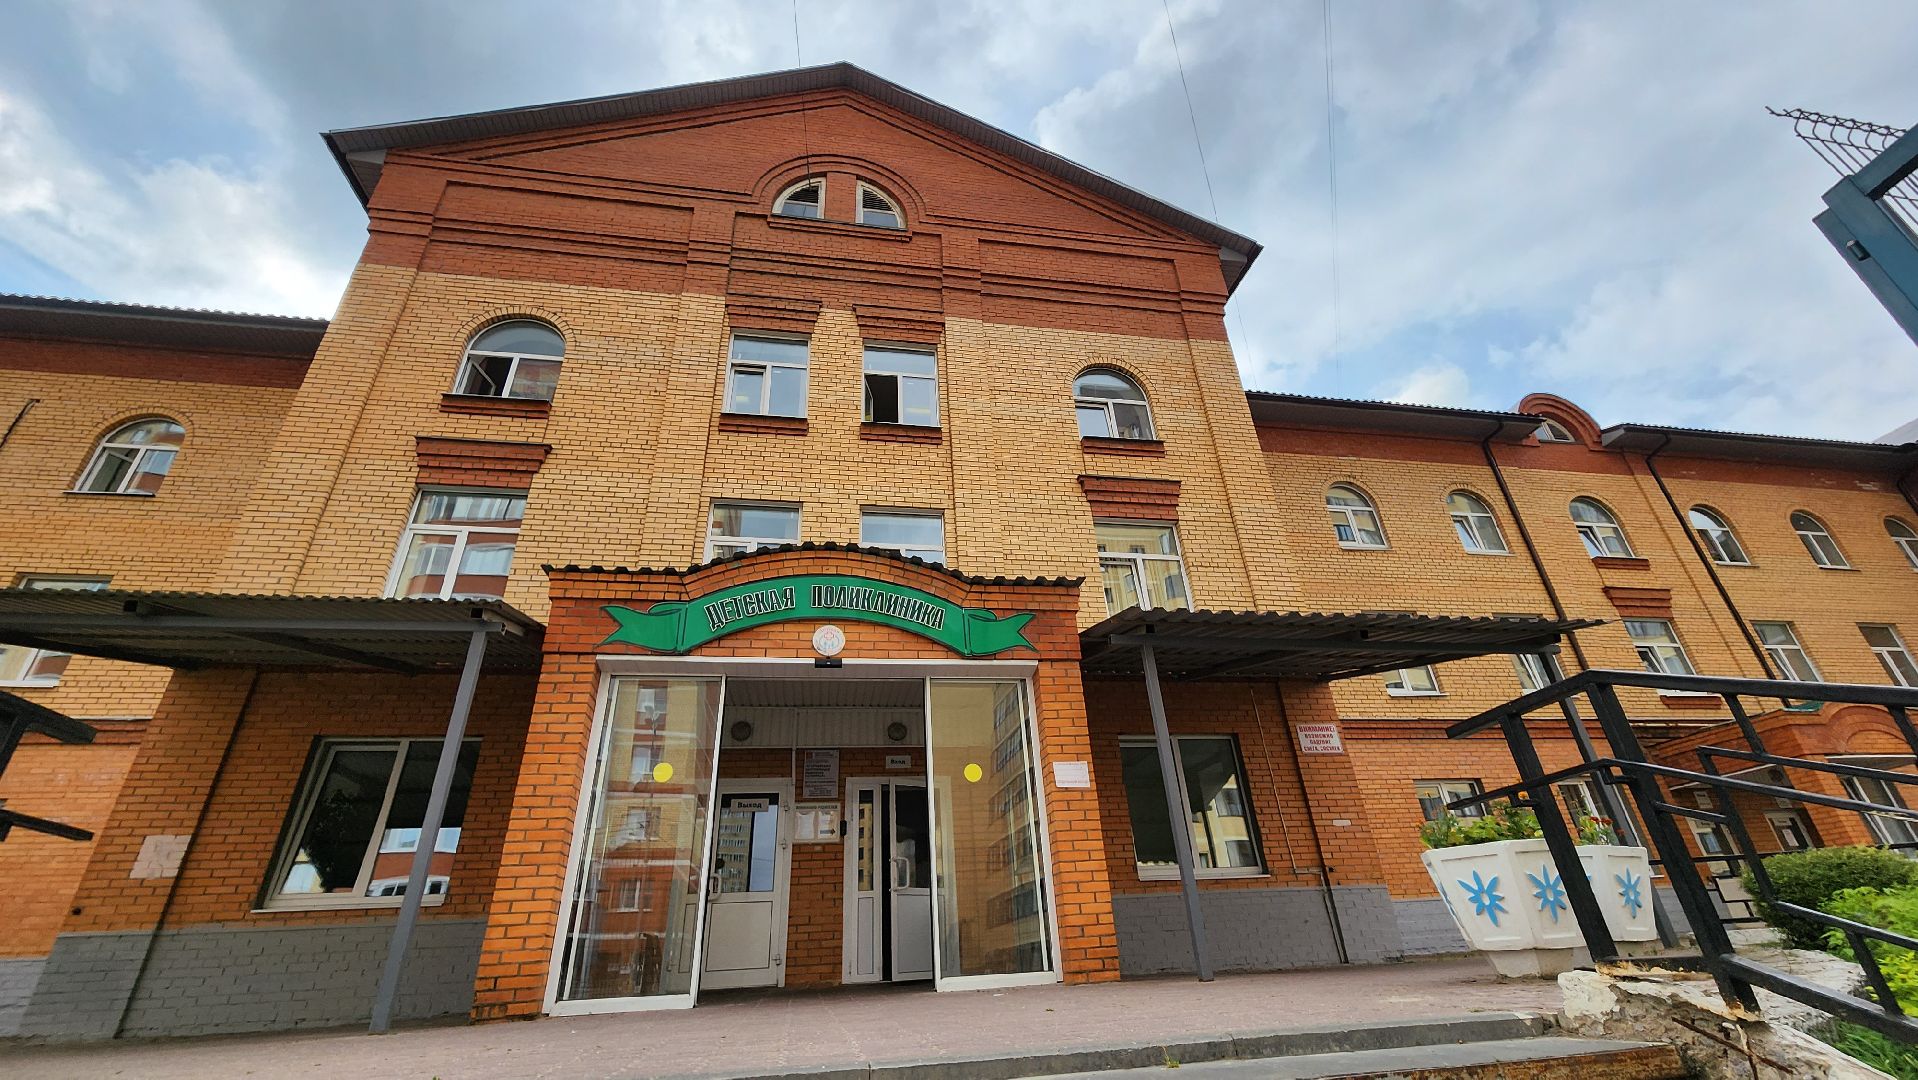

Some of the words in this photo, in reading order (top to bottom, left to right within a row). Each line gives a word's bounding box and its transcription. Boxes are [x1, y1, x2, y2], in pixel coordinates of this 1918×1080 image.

[704, 586, 795, 631] ДЕТСКАЯ
[811, 584, 945, 630] ПОЛИКЛИНИКА
[737, 801, 762, 809] Выход
